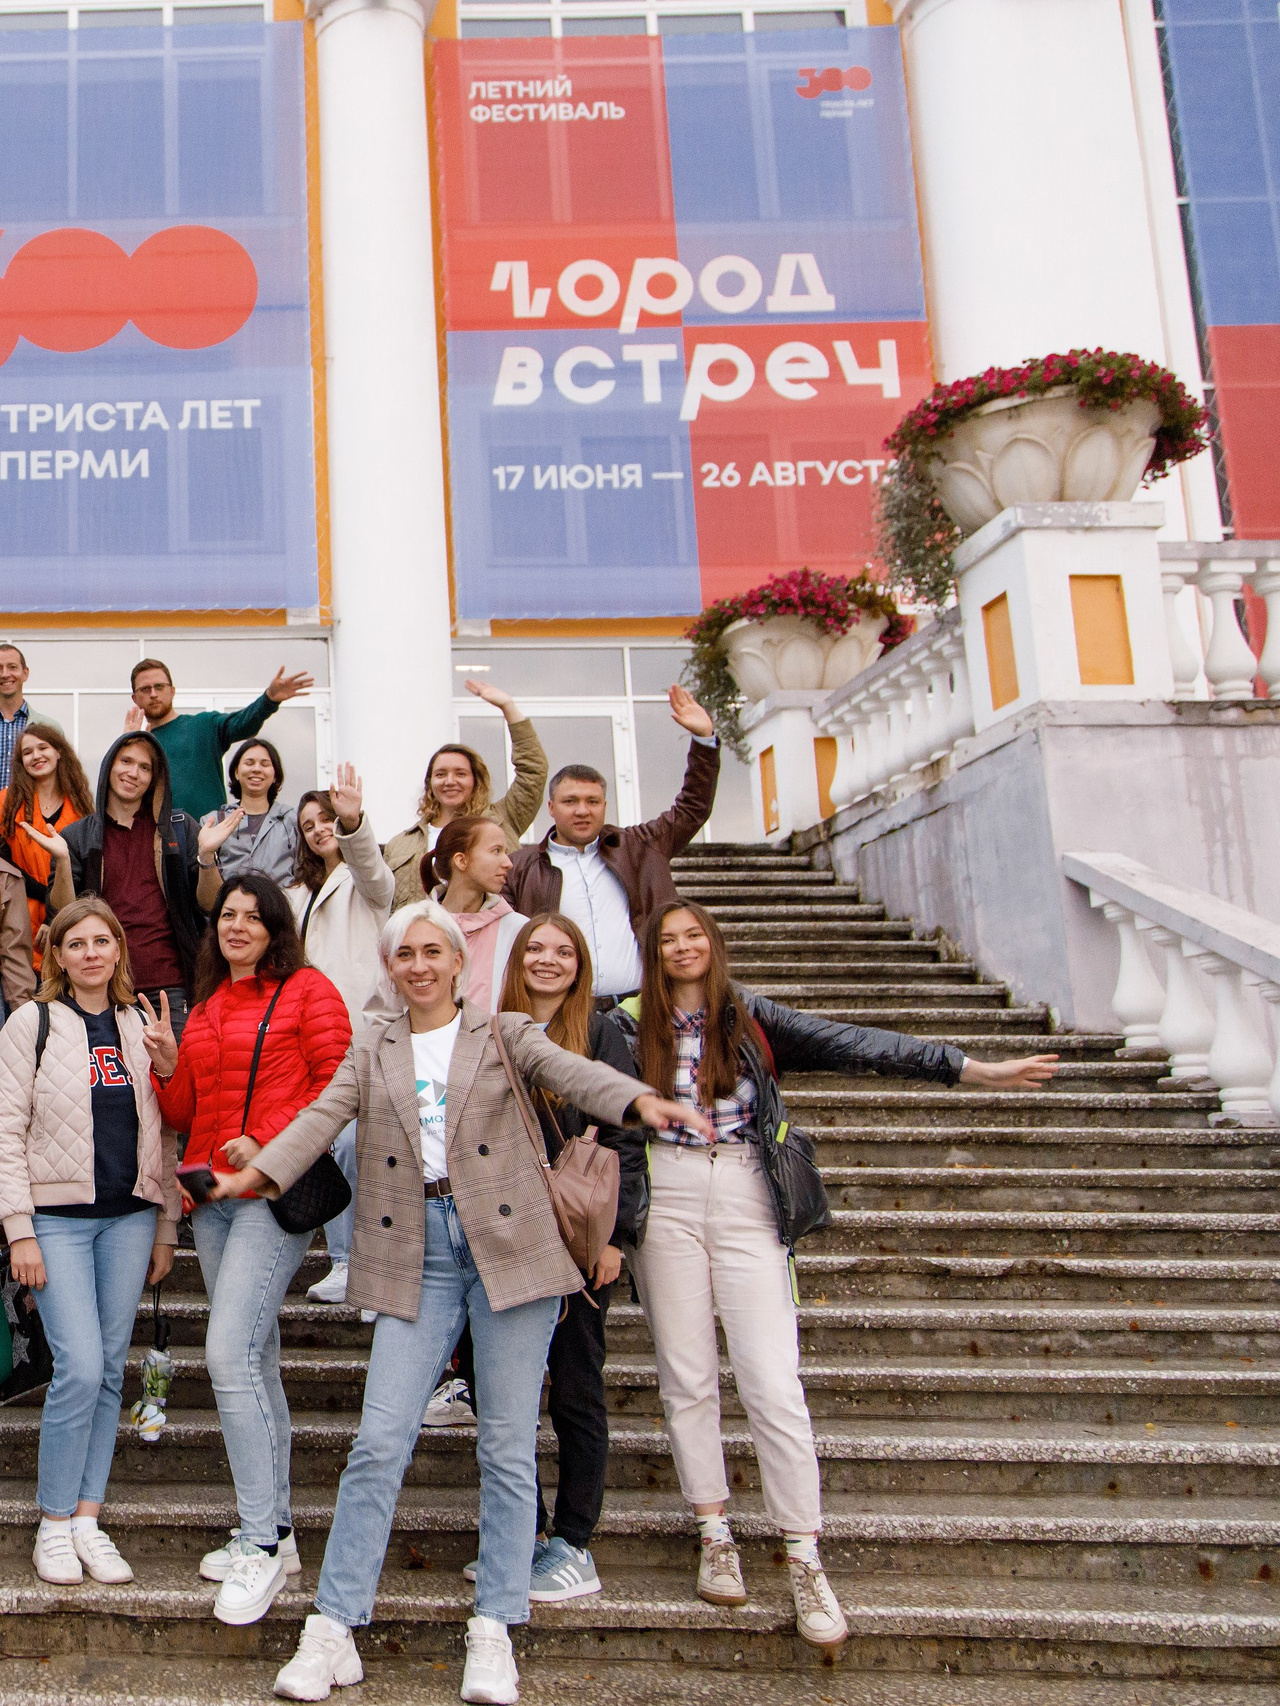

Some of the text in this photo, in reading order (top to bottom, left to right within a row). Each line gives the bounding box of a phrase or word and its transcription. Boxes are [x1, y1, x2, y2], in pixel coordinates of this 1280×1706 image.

[468, 75, 572, 99] ЛЕТНИЙ
[469, 101, 626, 123] ФЕСТИВАЛЬ
[0, 399, 261, 433] ТРИСТА ЛЕТ
[0, 449, 150, 480] ПЕРМИ
[493, 465, 522, 491] 17
[533, 464, 643, 490] ИЮНЯ
[700, 462, 741, 488] 26
